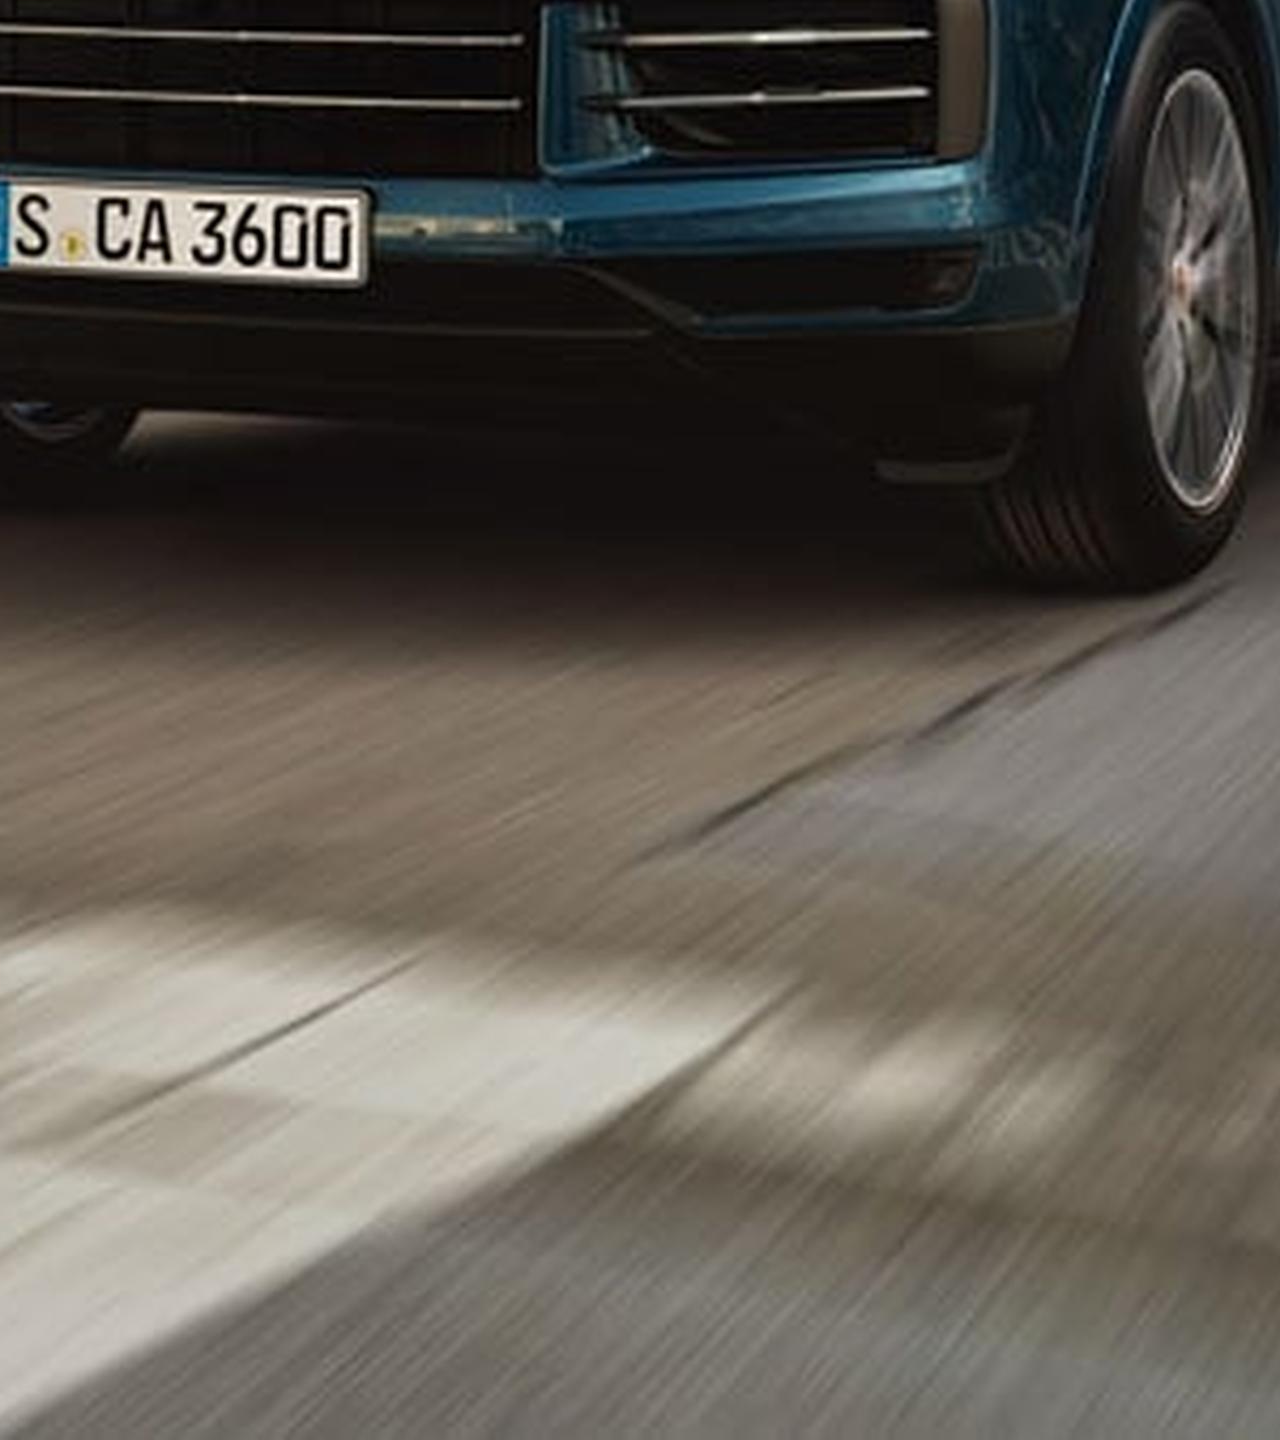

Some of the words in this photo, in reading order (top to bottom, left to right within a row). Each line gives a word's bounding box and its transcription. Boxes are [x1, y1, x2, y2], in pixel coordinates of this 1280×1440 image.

[15, 192, 51, 258] S
[95, 196, 174, 265] CA
[190, 200, 352, 270] 3600
